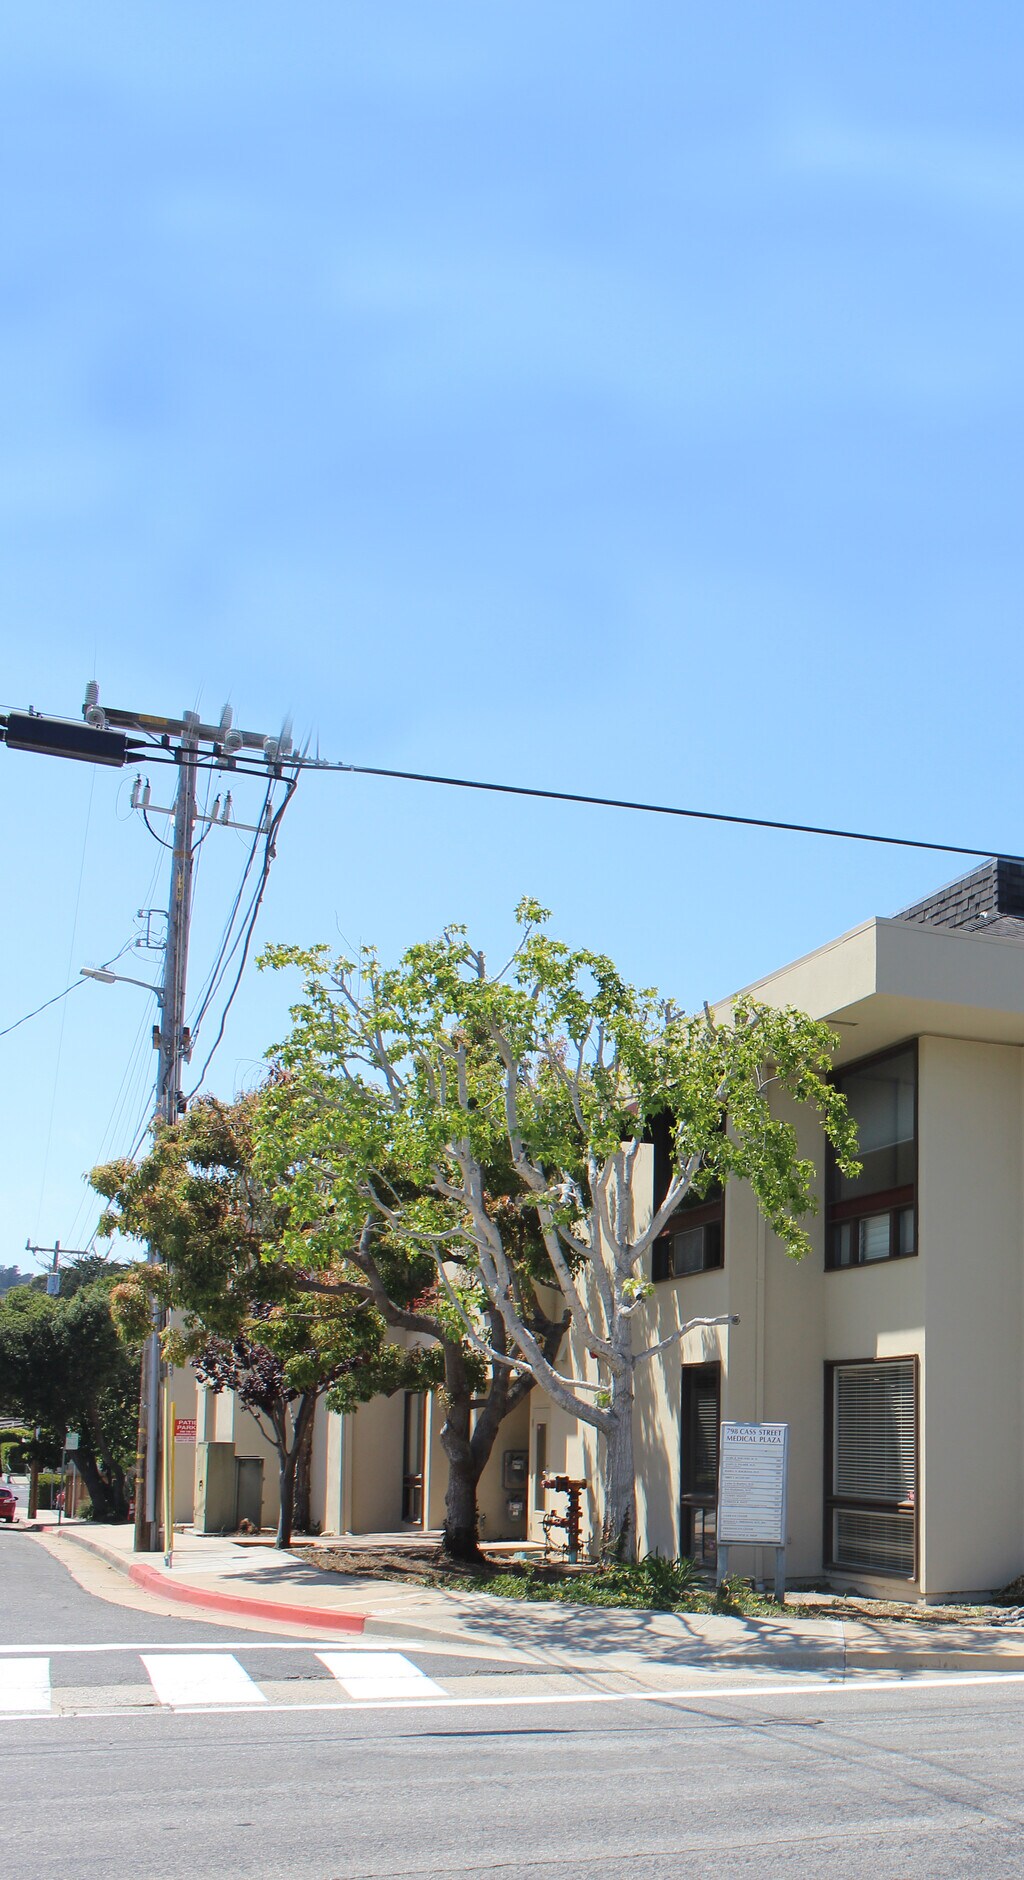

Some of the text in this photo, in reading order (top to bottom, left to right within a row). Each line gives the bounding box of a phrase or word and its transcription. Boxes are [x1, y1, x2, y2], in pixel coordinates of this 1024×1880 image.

[727, 1427, 739, 1435] 798
[739, 1428, 757, 1436] CASS
[727, 1435, 781, 1444] MEDICAL PLAZA
